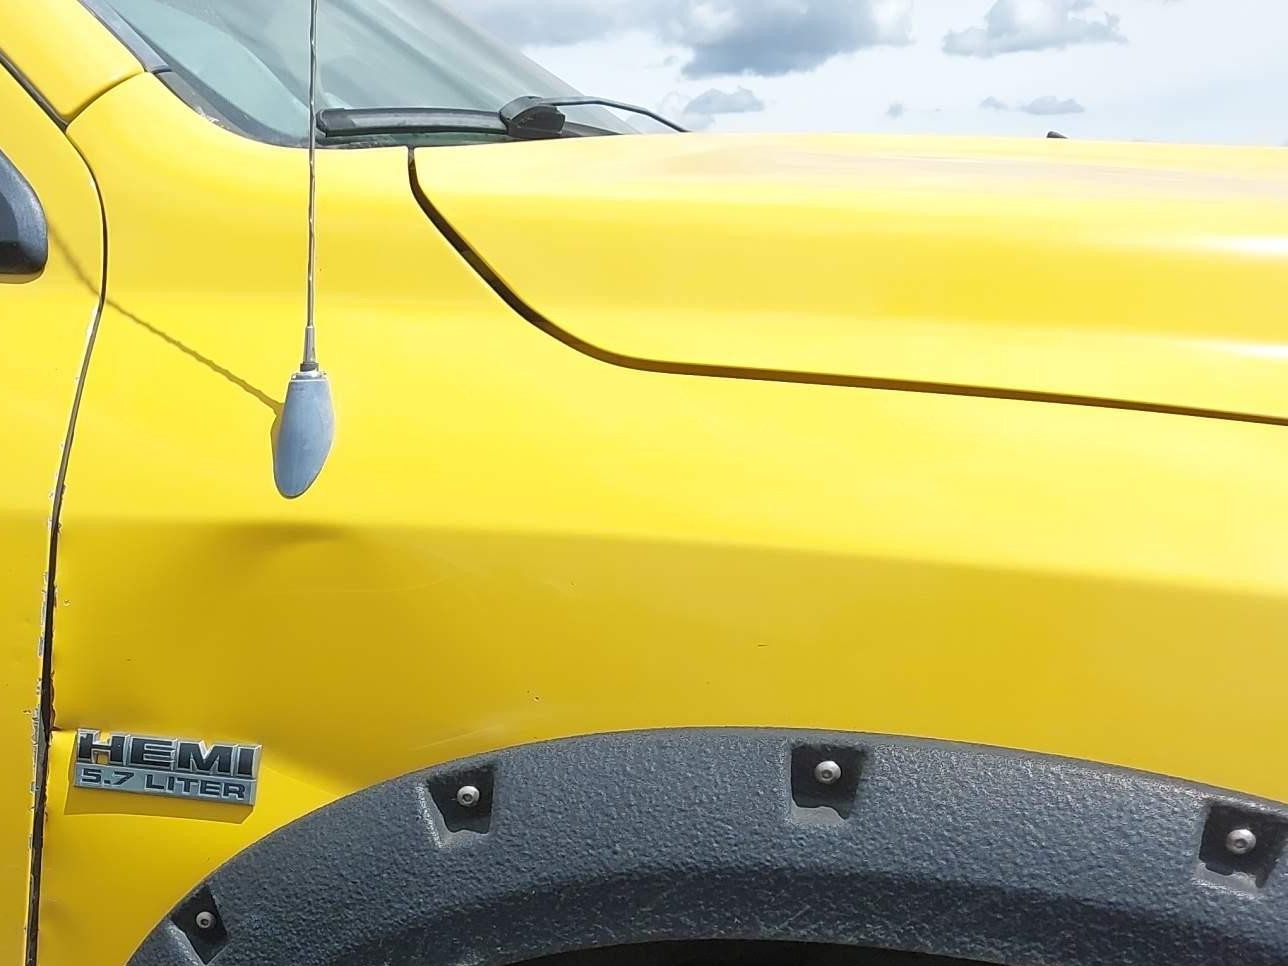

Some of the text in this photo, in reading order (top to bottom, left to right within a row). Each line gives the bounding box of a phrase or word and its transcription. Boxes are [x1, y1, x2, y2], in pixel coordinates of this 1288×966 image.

[77, 728, 263, 779] HEMI
[81, 767, 247, 800] 5.7 LITER
